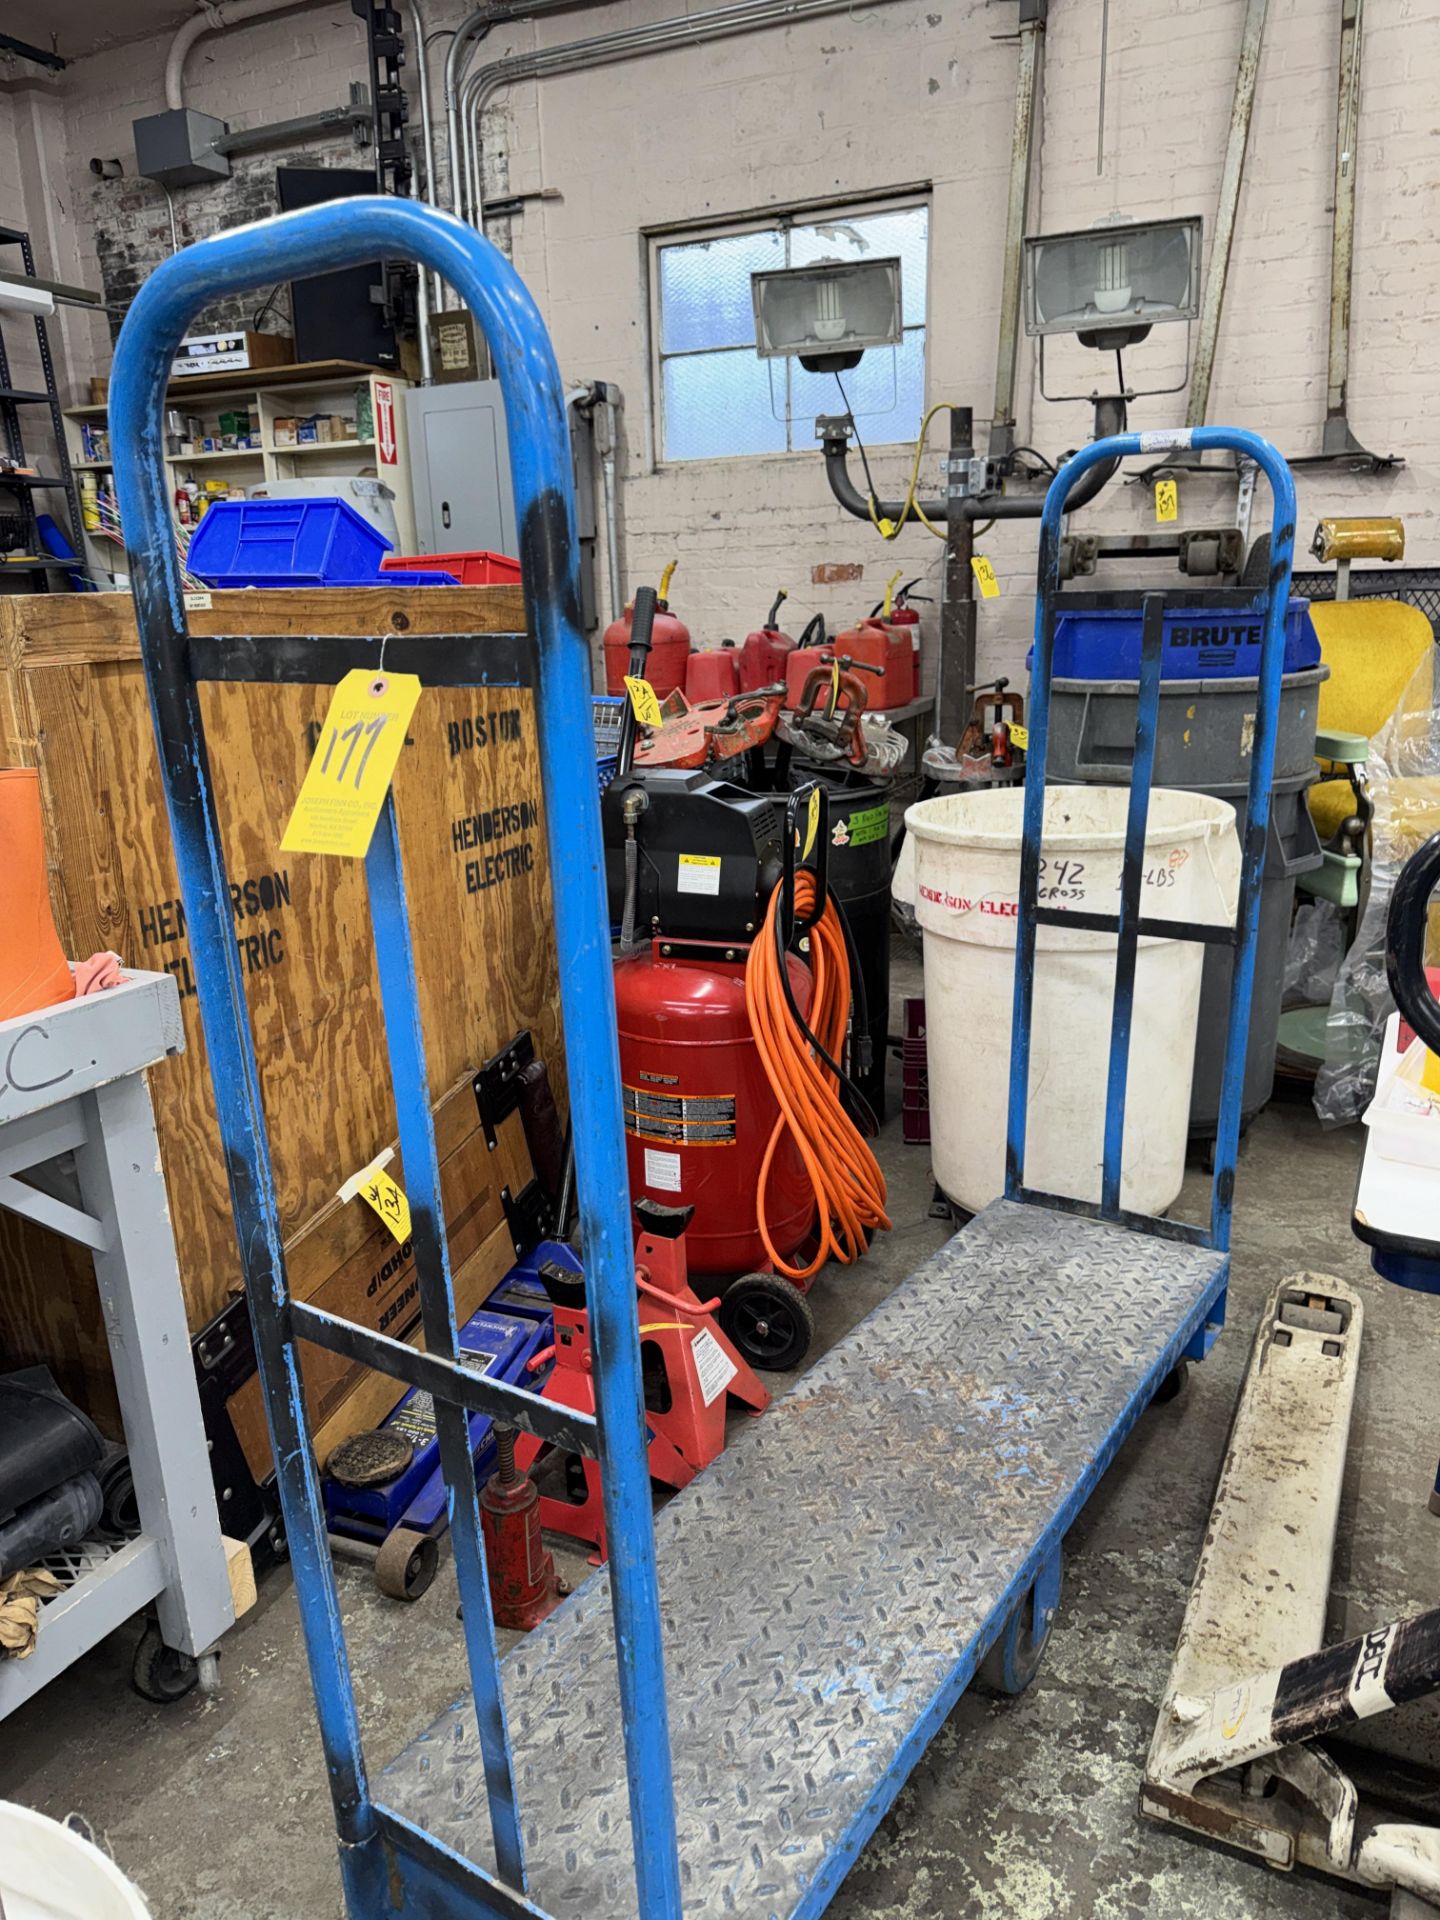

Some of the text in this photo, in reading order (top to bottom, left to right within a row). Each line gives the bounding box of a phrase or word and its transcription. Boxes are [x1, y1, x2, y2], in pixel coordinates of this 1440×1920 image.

[1170, 626, 1262, 647] BRUTE
[340, 711, 359, 720] LOT
[448, 709, 520, 758] BOSTON
[320, 714, 389, 790] 177
[452, 799, 538, 853] HENDERSON
[465, 843, 534, 894] ELECTRIC
[138, 870, 291, 949] HENRSON
